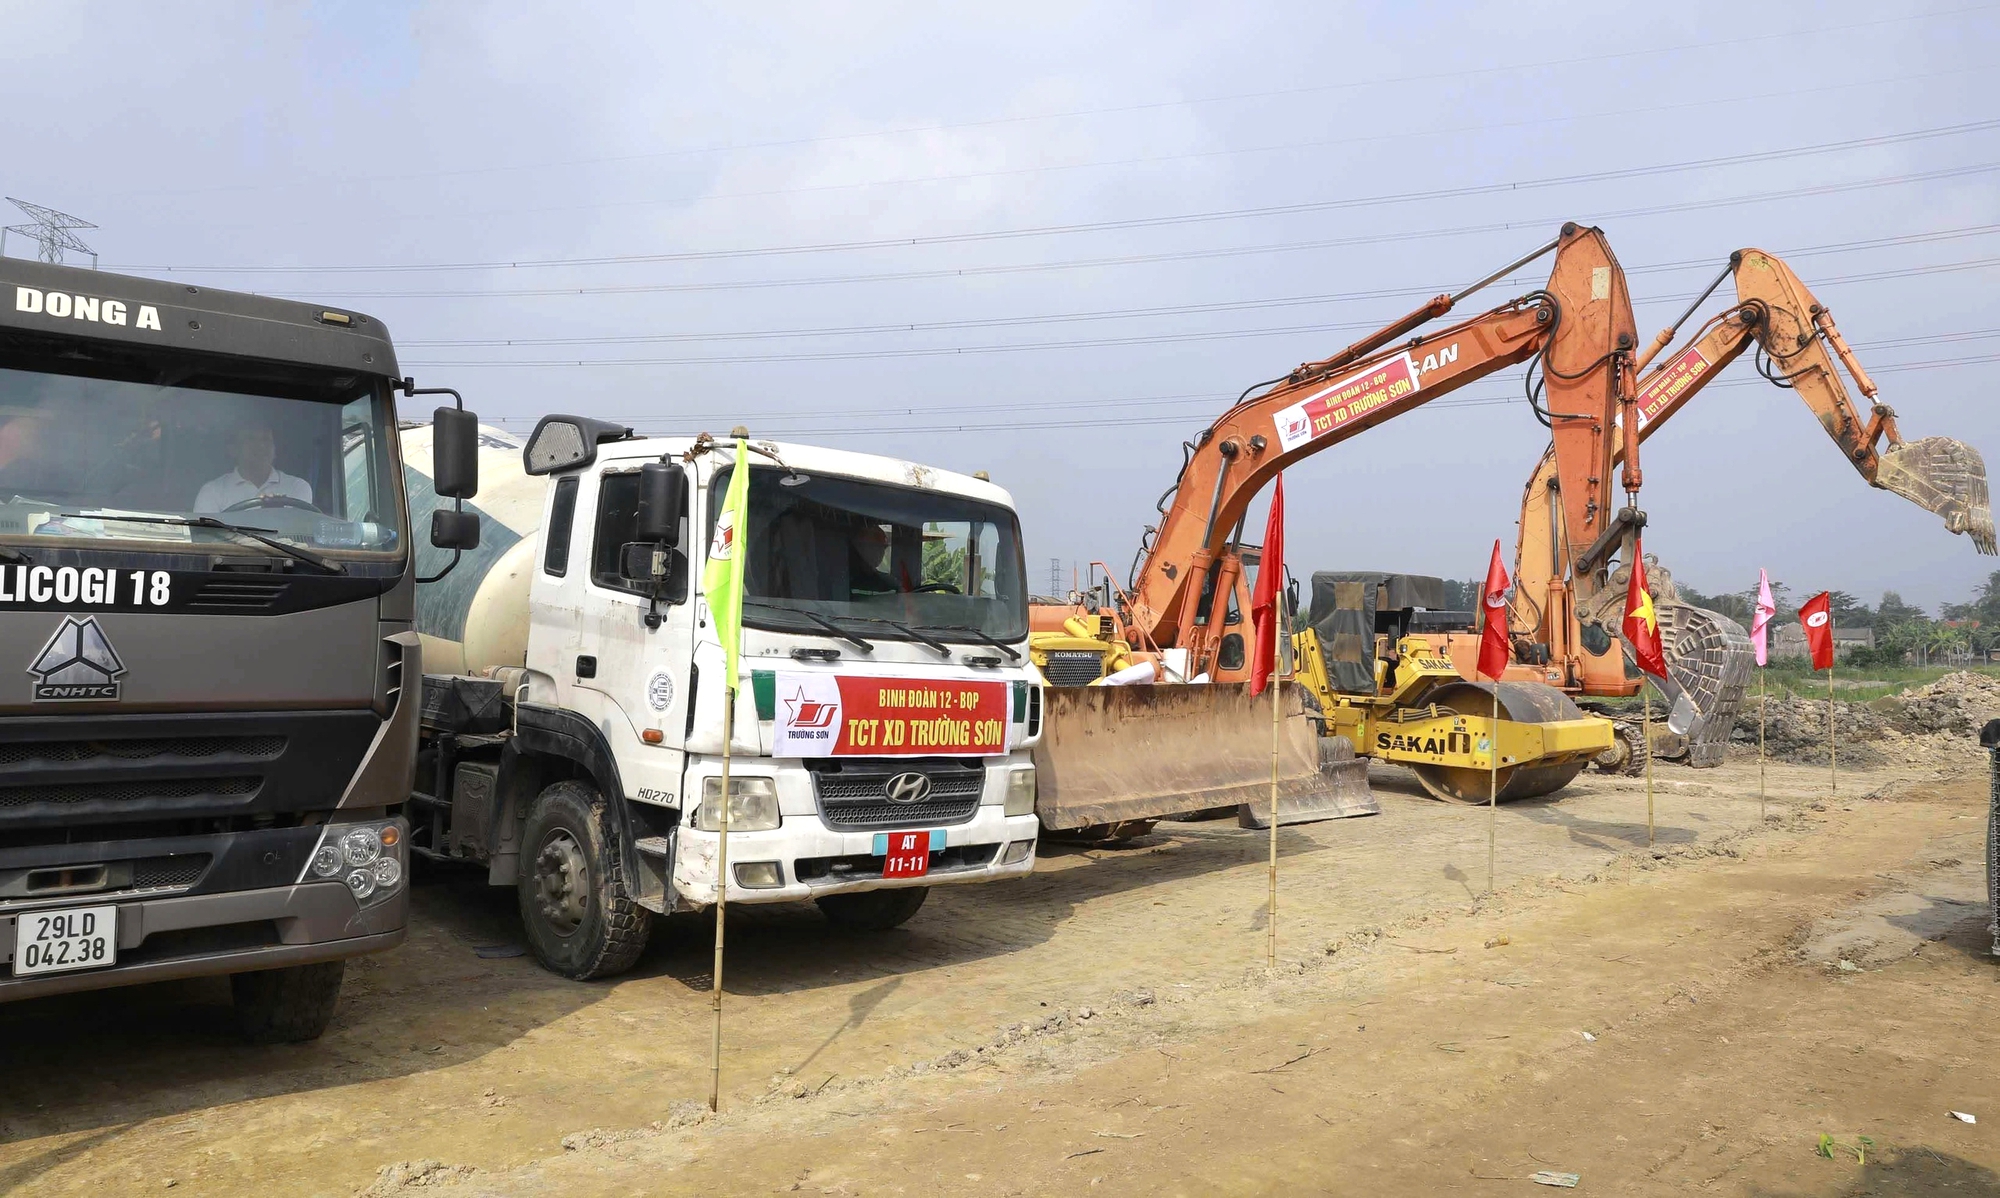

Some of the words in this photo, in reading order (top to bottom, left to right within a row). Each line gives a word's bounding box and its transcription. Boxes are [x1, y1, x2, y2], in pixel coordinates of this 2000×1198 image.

[16, 286, 127, 326] DONG
[136, 305, 162, 331] A
[1325, 394, 1343, 408] BINH
[1341, 385, 1360, 401] ĐOÀN
[1361, 381, 1370, 392] 12
[1373, 372, 1387, 386] BQP
[1645, 401, 1659, 415] TCT
[1657, 394, 1669, 406] XD
[1665, 372, 1693, 397] TRƯỜNG
[1690, 359, 1707, 376] SƠN
[1314, 413, 1332, 432] TCT
[1332, 407, 1348, 424] XD
[1347, 392, 1388, 416] TRƯỜNG
[1388, 378, 1411, 398] SƠN
[0, 565, 117, 604] LICOGI
[130, 571, 171, 606] 18
[1054, 651, 1093, 659] KOMATSU
[38, 686, 115, 697] CNHTC
[879, 688, 906, 708] BINH
[908, 686, 937, 709] ĐOÀN
[939, 691, 952, 709] 12
[959, 691, 980, 711] BQP
[788, 728, 815, 739] TRƯỜNG
[815, 729, 830, 739] SƠN
[848, 719, 879, 746] TCT
[882, 719, 905, 746] XD
[910, 713, 970, 746] TRƯỜNG
[973, 718, 1003, 746] SƠN
[1377, 732, 1446, 755] SAKAI
[637, 787, 675, 804] HD270
[901, 834, 918, 850] AT
[889, 856, 924, 872] 11-11
[36, 912, 95, 941] 29LD
[25, 937, 106, 968] 042.38
